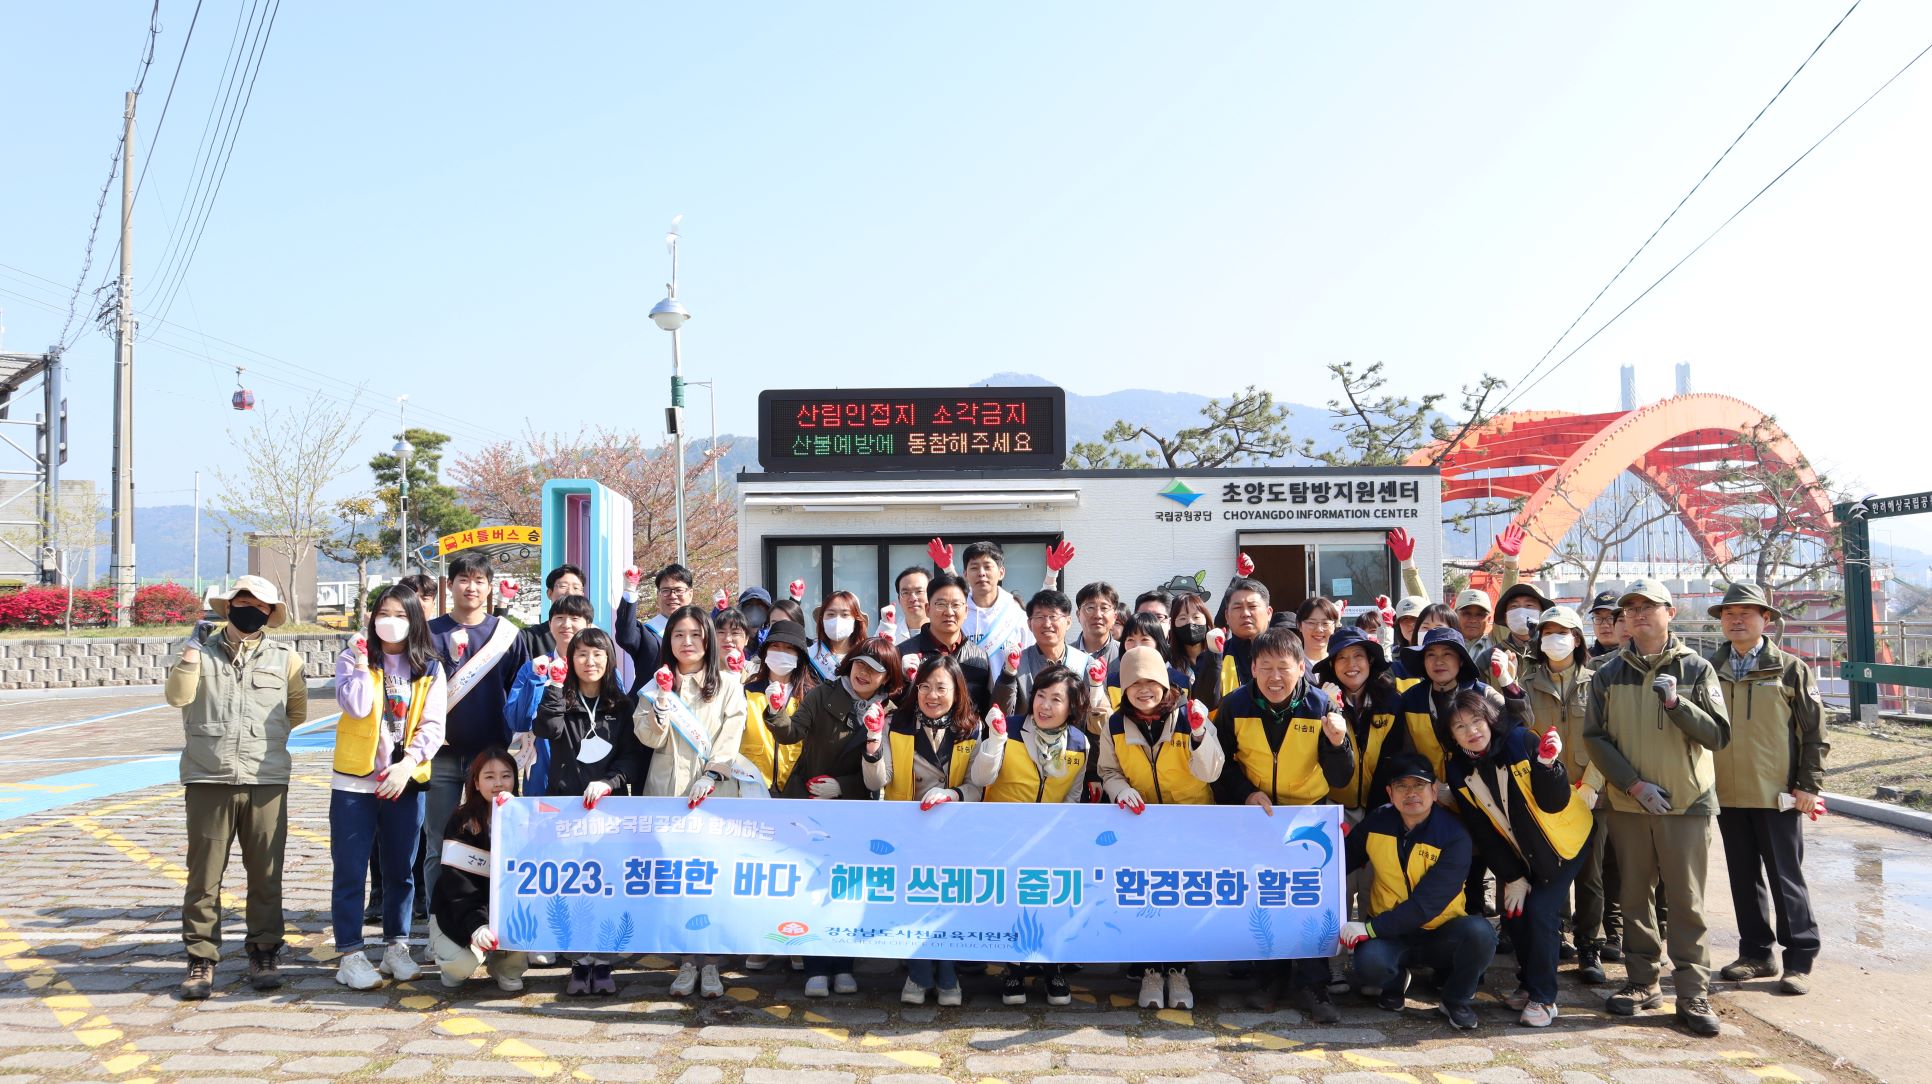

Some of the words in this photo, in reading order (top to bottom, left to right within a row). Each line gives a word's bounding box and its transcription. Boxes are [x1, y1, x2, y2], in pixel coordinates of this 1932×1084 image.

[796, 402, 915, 427] 산림인접지
[932, 402, 1026, 425] 소각금지
[792, 434, 894, 456] 산불예방에
[907, 432, 1033, 454] 동참해주세요
[1222, 480, 1420, 505] 초양도탐방지원센터
[1872, 494, 1932, 515] 한려해상국립공
[1155, 510, 1212, 522] 국립공원공단
[1223, 510, 1295, 521] CHOYANGDO
[1296, 509, 1370, 520] INFORMATION
[1373, 508, 1419, 519] CENTER
[461, 528, 520, 545] 셔틀버스
[707, 817, 776, 841] 함께하는
[624, 858, 719, 895] 청렴한
[733, 862, 801, 898] 바다
[830, 864, 896, 902] 해변
[907, 866, 1006, 904] 쓰레기
[1115, 868, 1249, 907] 환경정화
[1257, 868, 1322, 907] 활동
